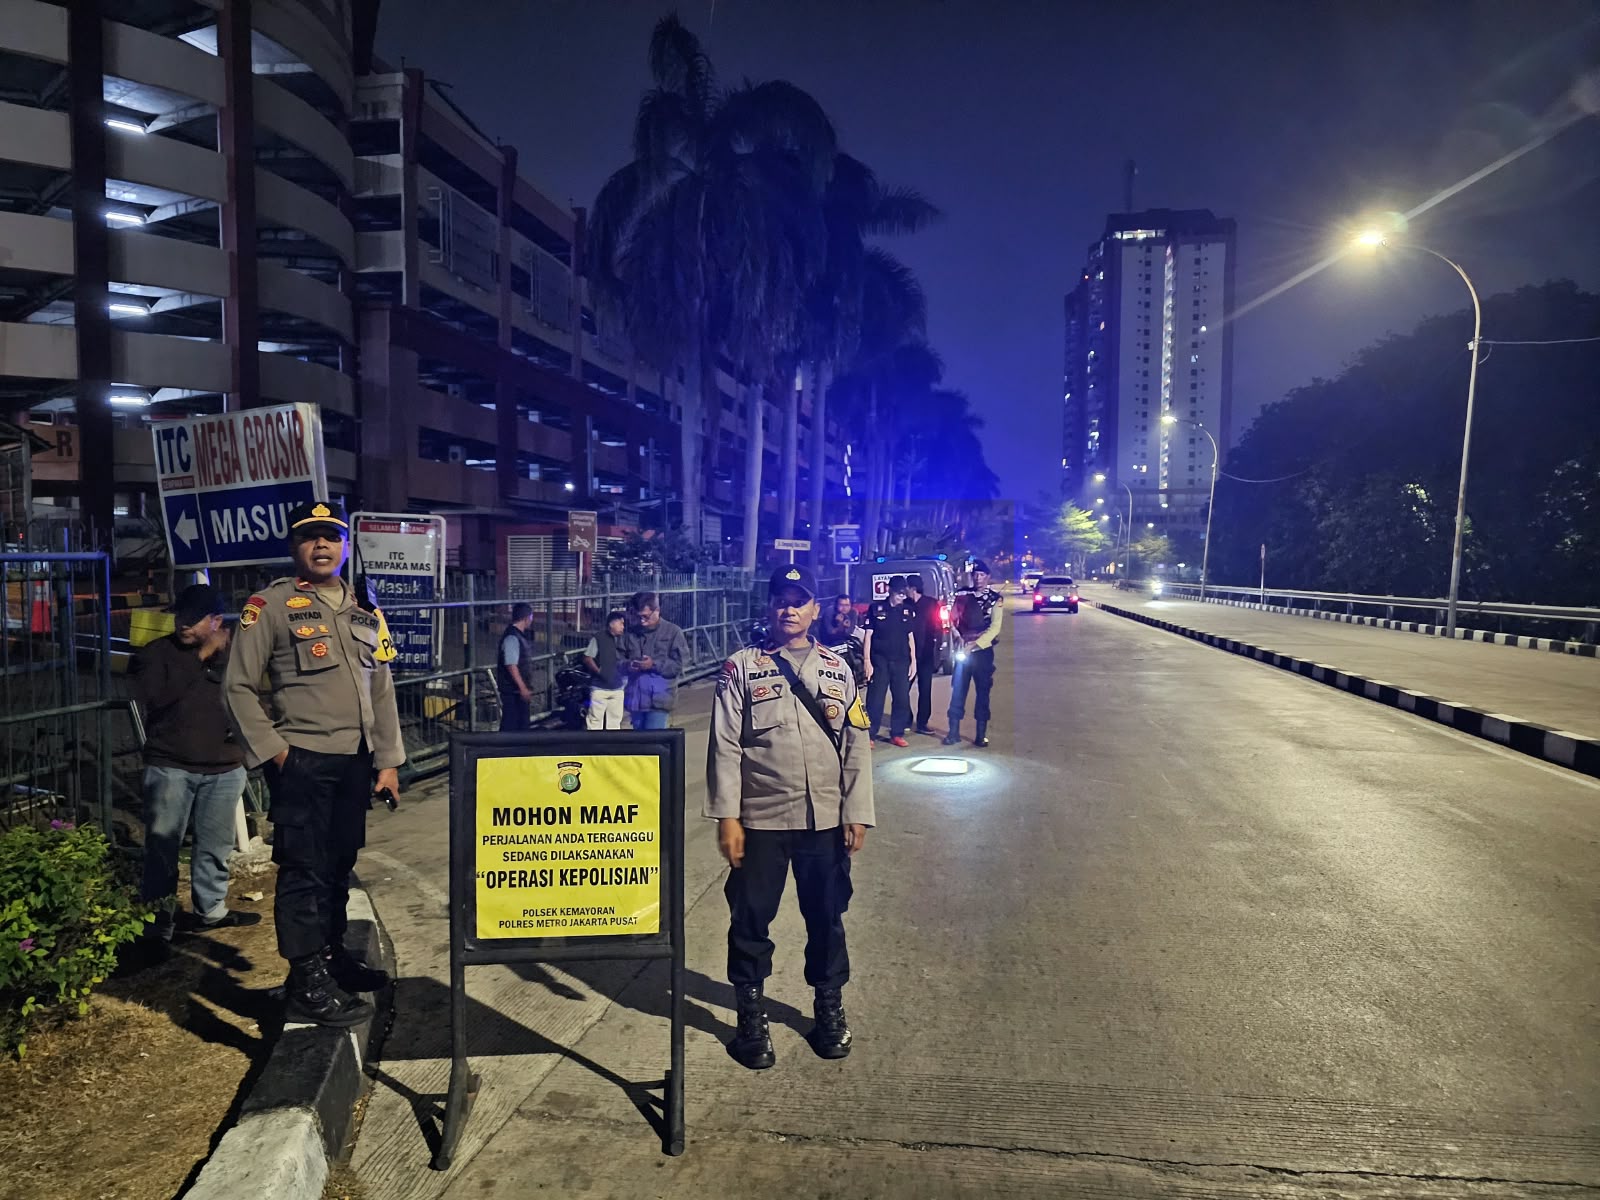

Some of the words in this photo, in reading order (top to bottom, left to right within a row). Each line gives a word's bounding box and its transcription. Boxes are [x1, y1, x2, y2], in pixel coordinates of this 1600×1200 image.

[156, 426, 191, 474] ITC
[193, 419, 244, 487] MEGA
[243, 409, 310, 481] GROSIR
[210, 501, 304, 544] MASU
[389, 551, 405, 560] ITC
[363, 561, 408, 570] CEMPAKA
[410, 562, 431, 571] MAS
[351, 614, 378, 628] POLRI
[492, 807, 572, 826] MOHON
[580, 804, 639, 824] MAAF
[482, 833, 552, 845] PERJALANAN
[555, 833, 585, 844] ANDA
[587, 832, 654, 843] TERGANGGU
[502, 851, 548, 862] SEDANG
[550, 849, 634, 861] DILAKSANAKAN
[522, 908, 558, 918] POLSEK
[560, 907, 615, 916] KEMAYORAN
[499, 920, 534, 929] POLRES
[536, 919, 567, 928] METRO
[569, 918, 608, 927] JAKARTA
[610, 917, 638, 926] PUSAT
